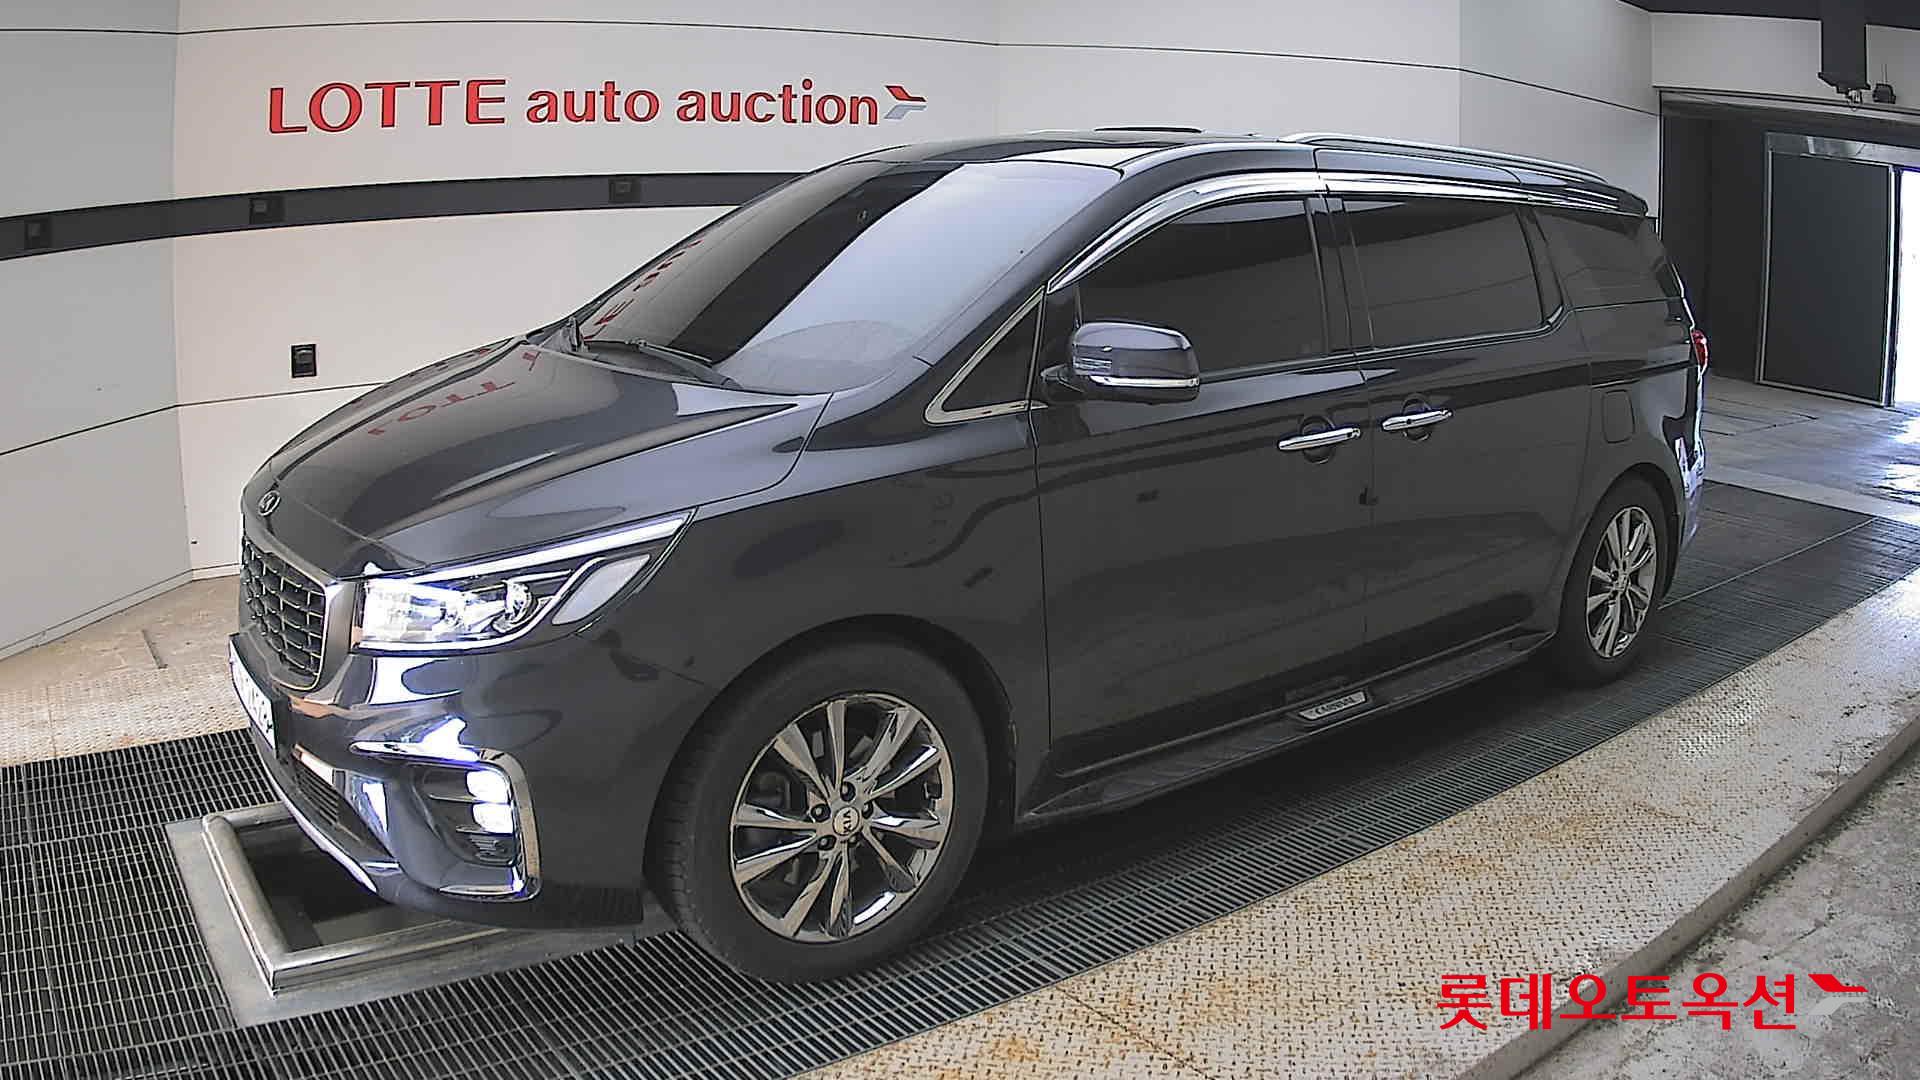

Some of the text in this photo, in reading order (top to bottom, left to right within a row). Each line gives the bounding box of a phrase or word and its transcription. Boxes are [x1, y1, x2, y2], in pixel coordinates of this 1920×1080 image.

[268, 79, 878, 134] LOTTE auto auction
